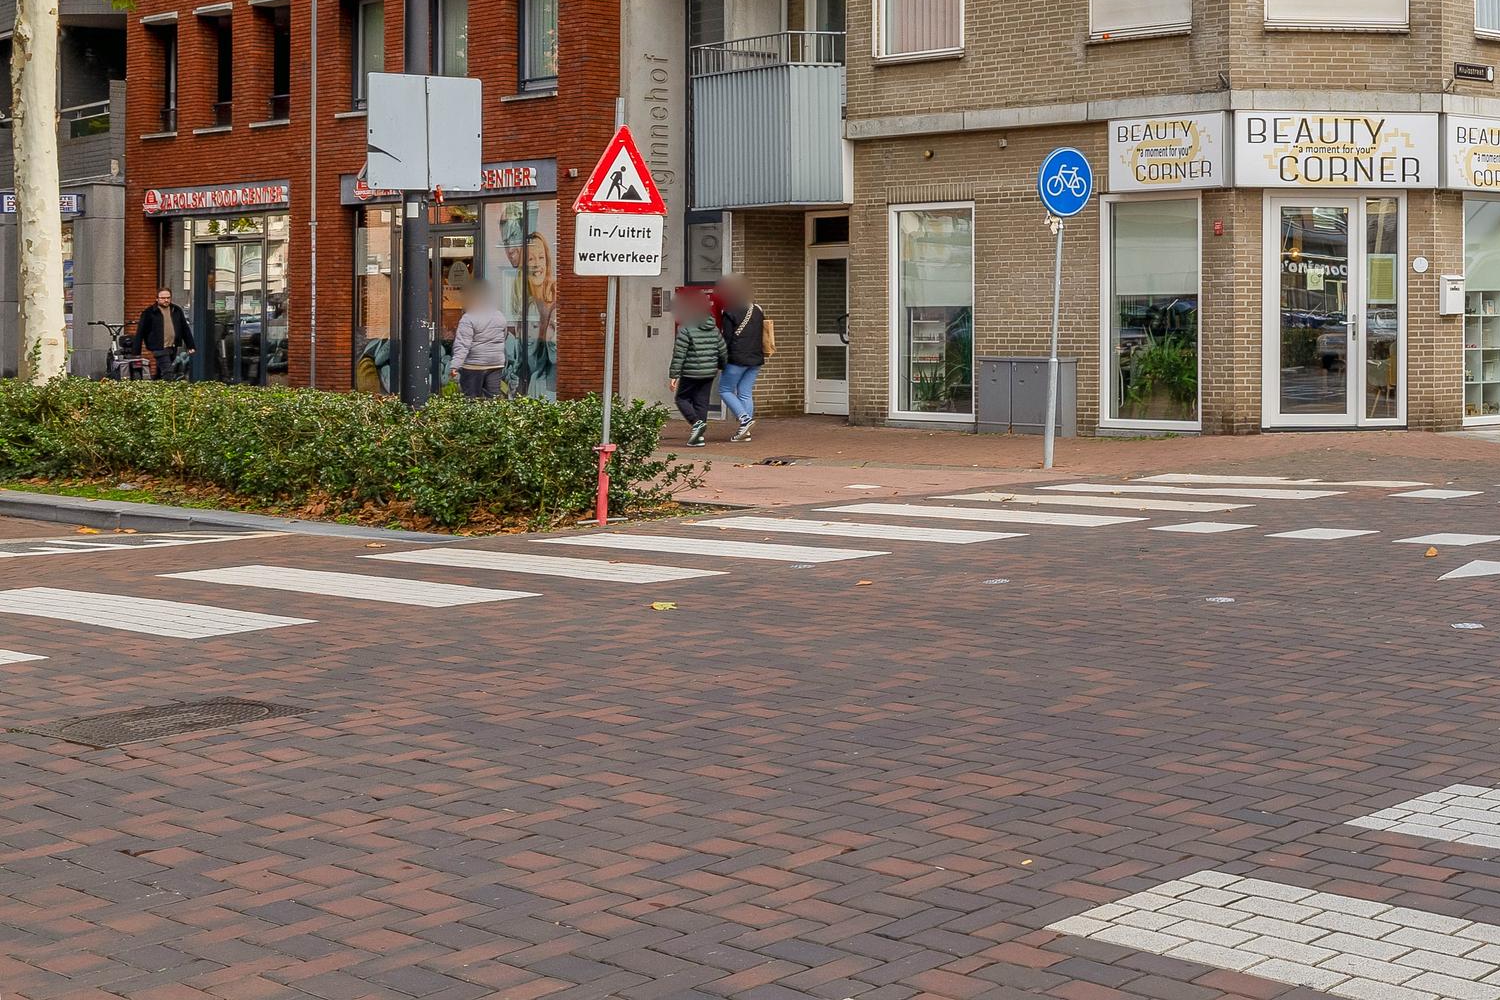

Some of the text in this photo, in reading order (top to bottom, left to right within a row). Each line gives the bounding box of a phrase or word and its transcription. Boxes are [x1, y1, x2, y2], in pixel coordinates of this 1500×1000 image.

[1117, 120, 1193, 143] BEAUTY
[1247, 117, 1386, 145] BEAUTY
[1144, 147, 1168, 158] moment
[1168, 144, 1178, 157] for
[1305, 145, 1341, 154] moment
[1342, 144, 1354, 154] for
[1135, 160, 1212, 182] CORNER
[1279, 155, 1421, 183] CORNER
[211, 188, 238, 208] FOOD
[241, 185, 283, 205] CENTER
[588, 224, 652, 239] in-/uitrit
[578, 250, 660, 263] werkverkeer
